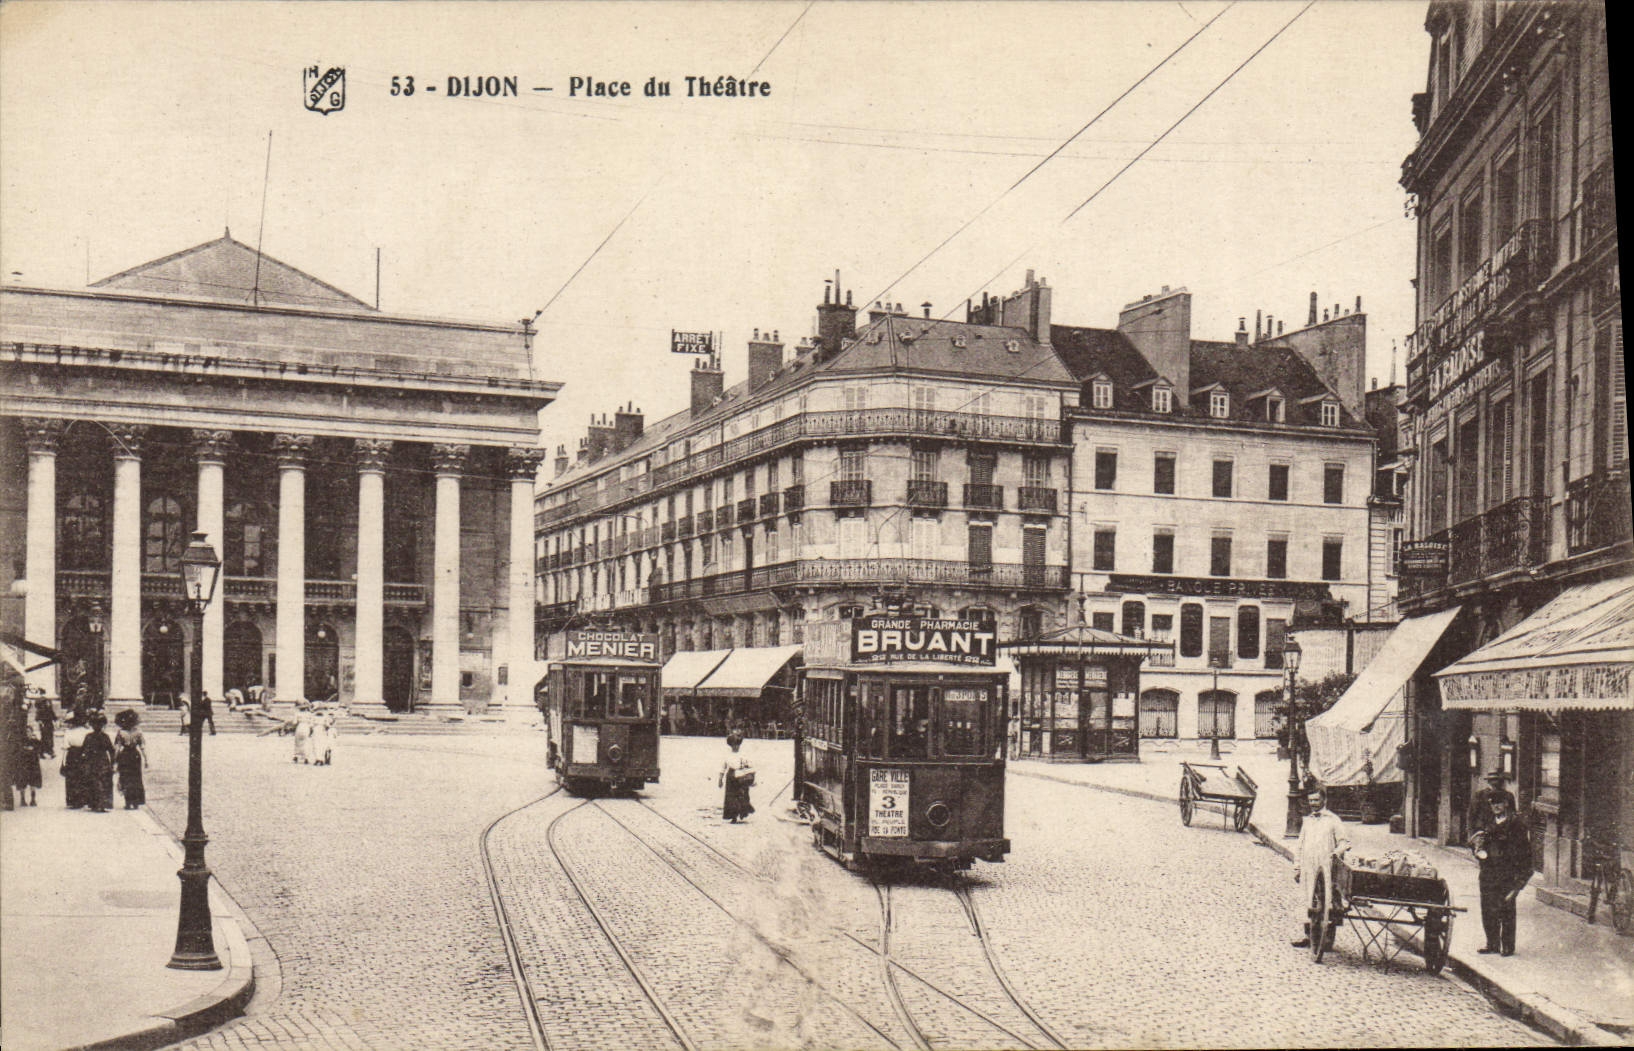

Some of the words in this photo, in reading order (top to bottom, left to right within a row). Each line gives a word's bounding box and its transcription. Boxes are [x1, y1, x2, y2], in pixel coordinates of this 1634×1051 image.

[674, 333, 710, 345] ARRET
[677, 343, 706, 353] FIXE
[871, 619, 911, 630] GRANDE
[920, 620, 979, 631] PHARMACIE
[578, 632, 645, 642] CHOCOLAT
[858, 630, 994, 656] BRUANT
[568, 641, 655, 660] MENIER
[872, 769, 888, 783] GARE
[891, 769, 909, 783] VILLE
[881, 795, 897, 810] 3
[875, 810, 904, 819] THEATRE
